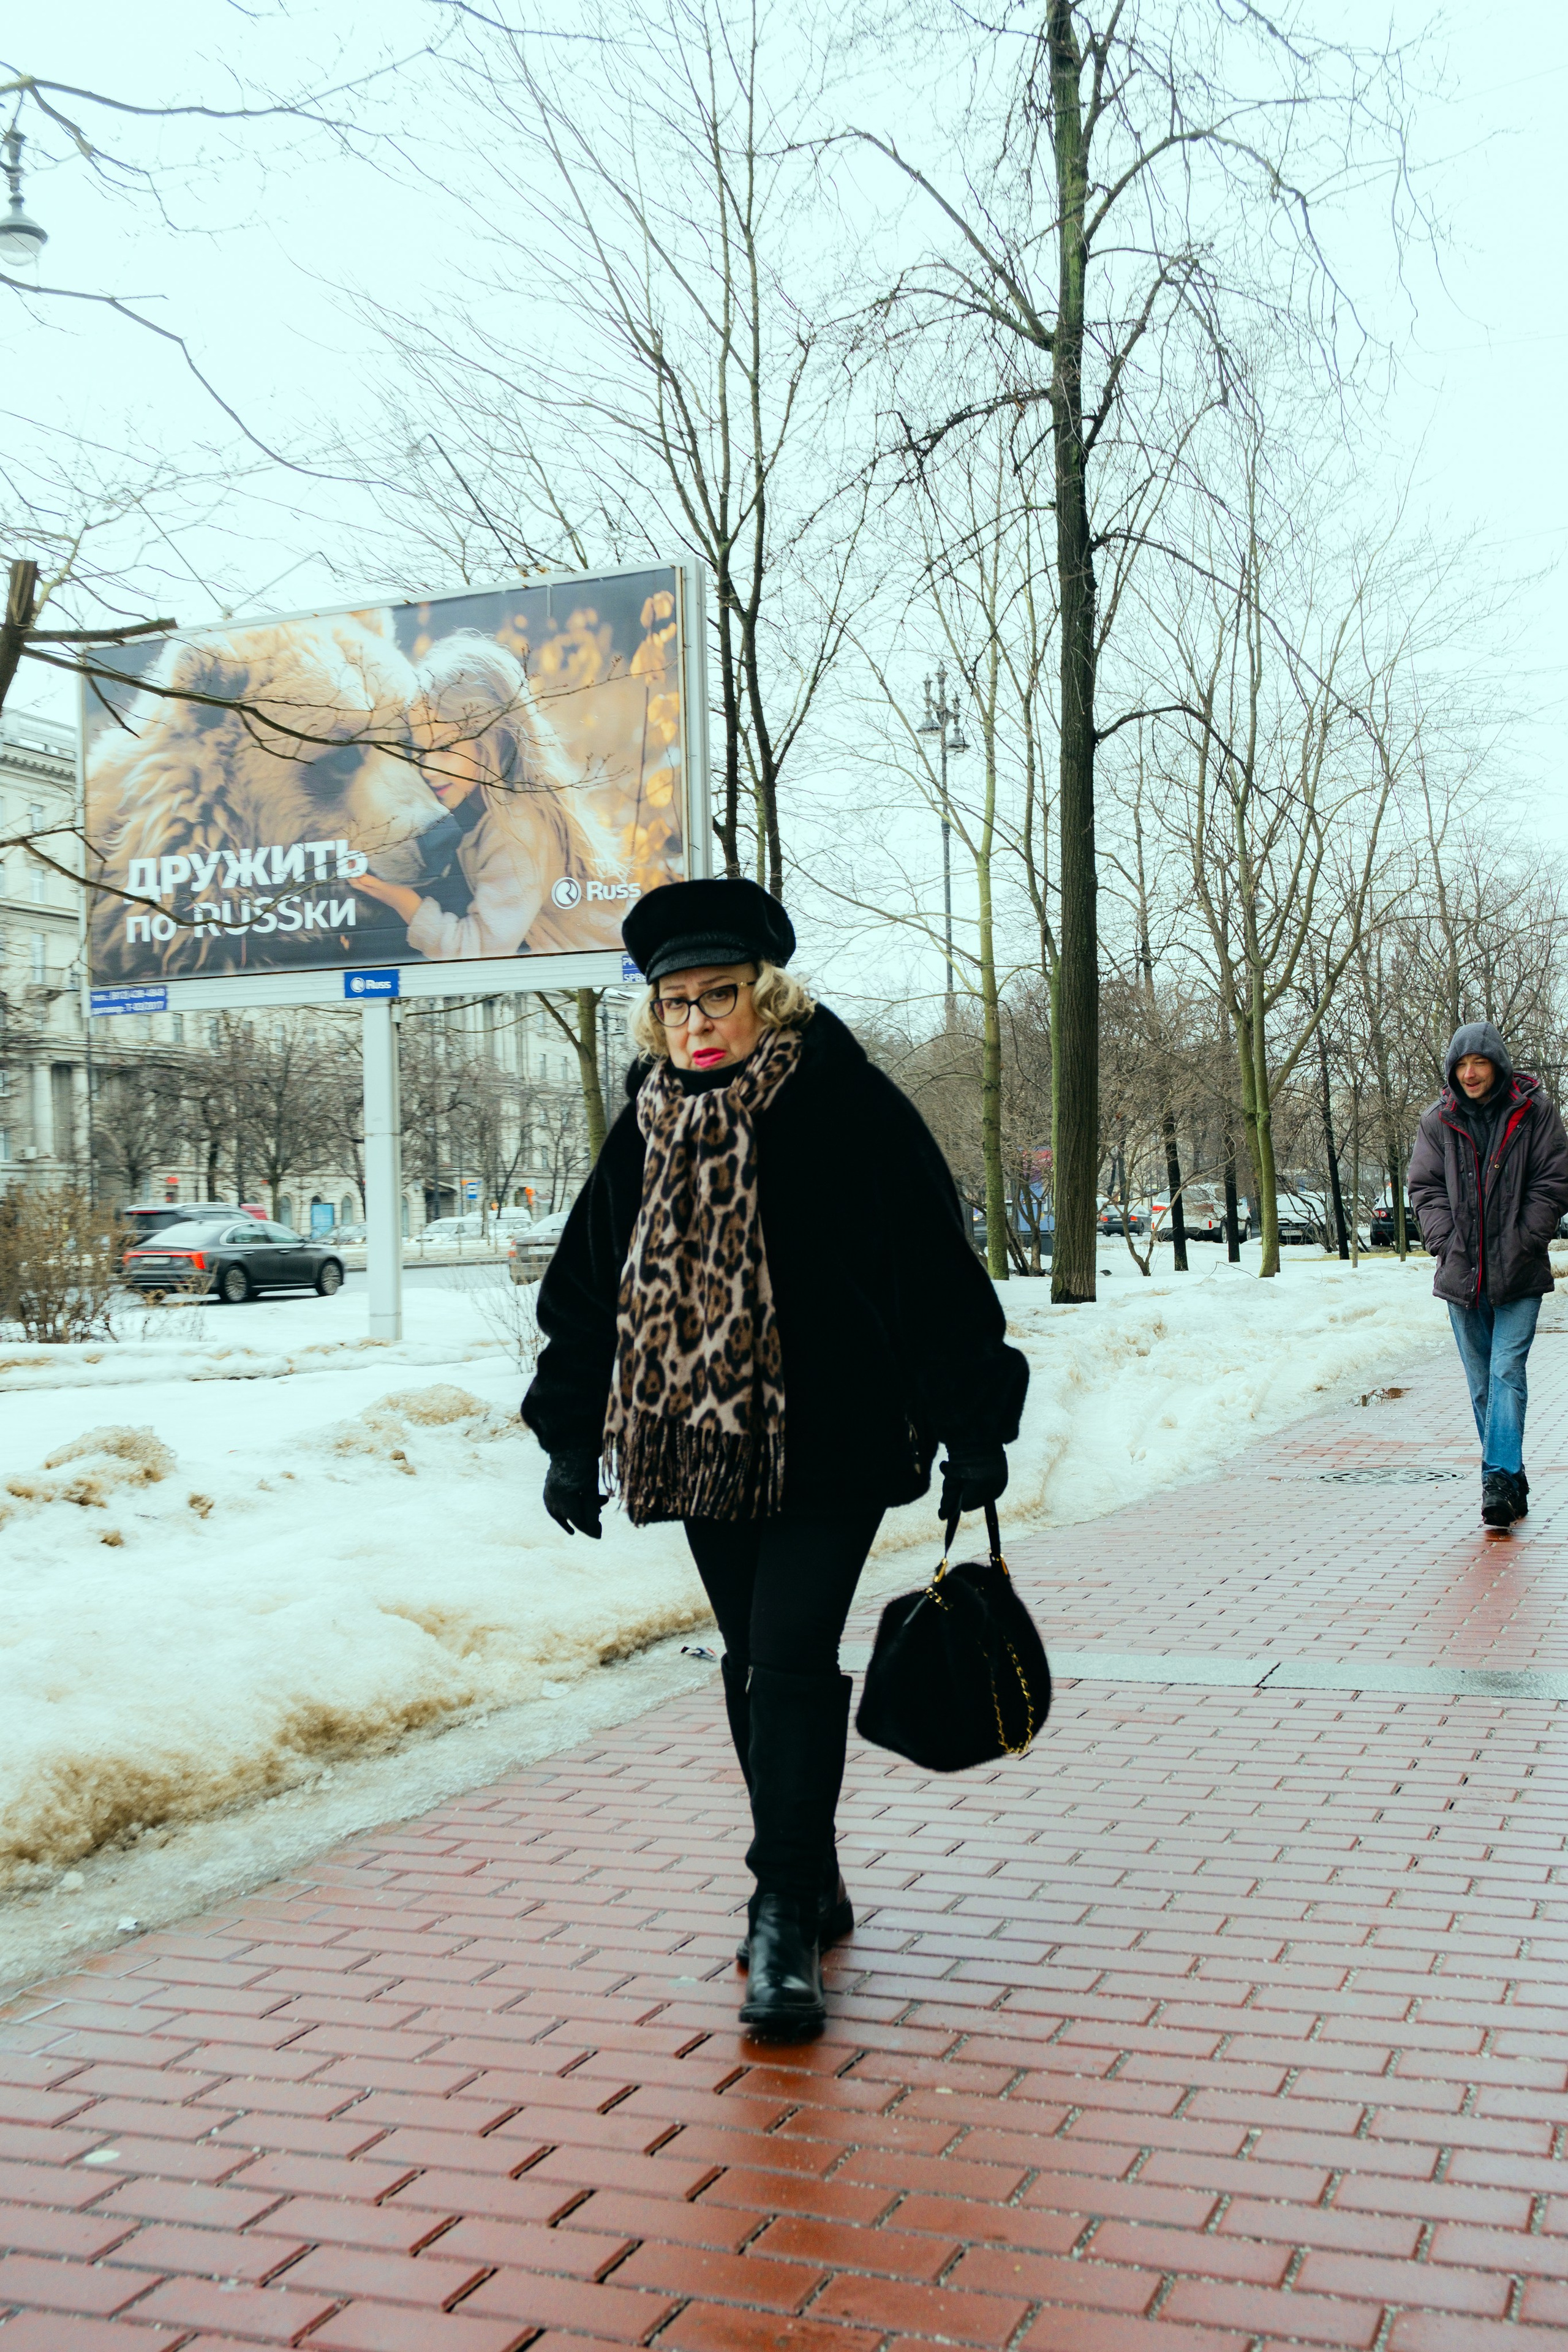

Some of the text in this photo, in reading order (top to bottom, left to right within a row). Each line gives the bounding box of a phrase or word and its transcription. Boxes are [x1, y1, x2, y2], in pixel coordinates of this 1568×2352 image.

[124, 840, 368, 905] ДРУЖИТЬ
[586, 881, 641, 901] Russ
[365, 979, 392, 989] Russ
